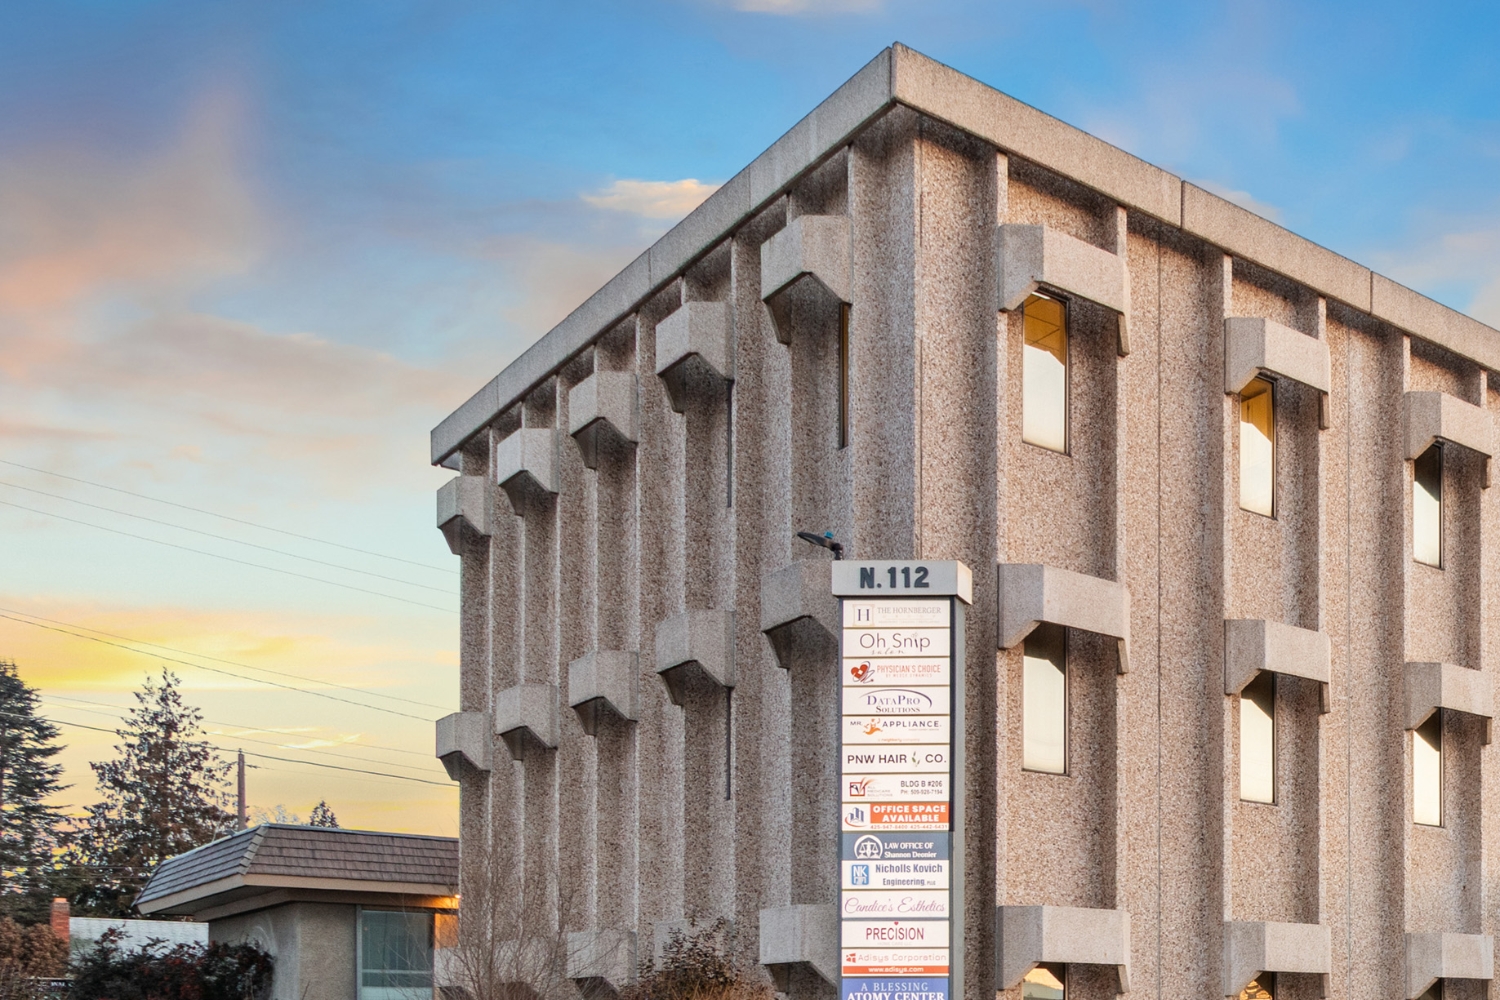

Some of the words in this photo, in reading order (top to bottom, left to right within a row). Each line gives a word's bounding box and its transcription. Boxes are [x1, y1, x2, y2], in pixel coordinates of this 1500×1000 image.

[892, 606, 942, 614] HORNBERGER
[859, 632, 886, 649] Oh
[892, 632, 931, 652] Snip
[917, 664, 942, 673] CHOICE
[847, 754, 876, 764] PNW
[878, 754, 908, 764] HAIR
[925, 753, 948, 764] CO.
[900, 780, 920, 788] BLDG
[920, 780, 927, 788] B
[927, 780, 943, 788] #206
[872, 804, 911, 813] OFFICE
[912, 804, 947, 813] SPACE
[881, 814, 940, 823] AVAILABLE
[884, 842, 900, 850] LAW
[899, 842, 924, 850] OFFICE
[924, 842, 935, 850] OF
[875, 864, 911, 873] Nicholls
[913, 864, 943, 873] Kovich
[844, 897, 894, 914] Candice's
[897, 897, 945, 913] Esthetics
[866, 928, 924, 940] PRECISION
[858, 953, 889, 962] Adisys
[891, 953, 947, 961] Corporation
[861, 983, 868, 991] A
[873, 983, 929, 991] BLESSING
